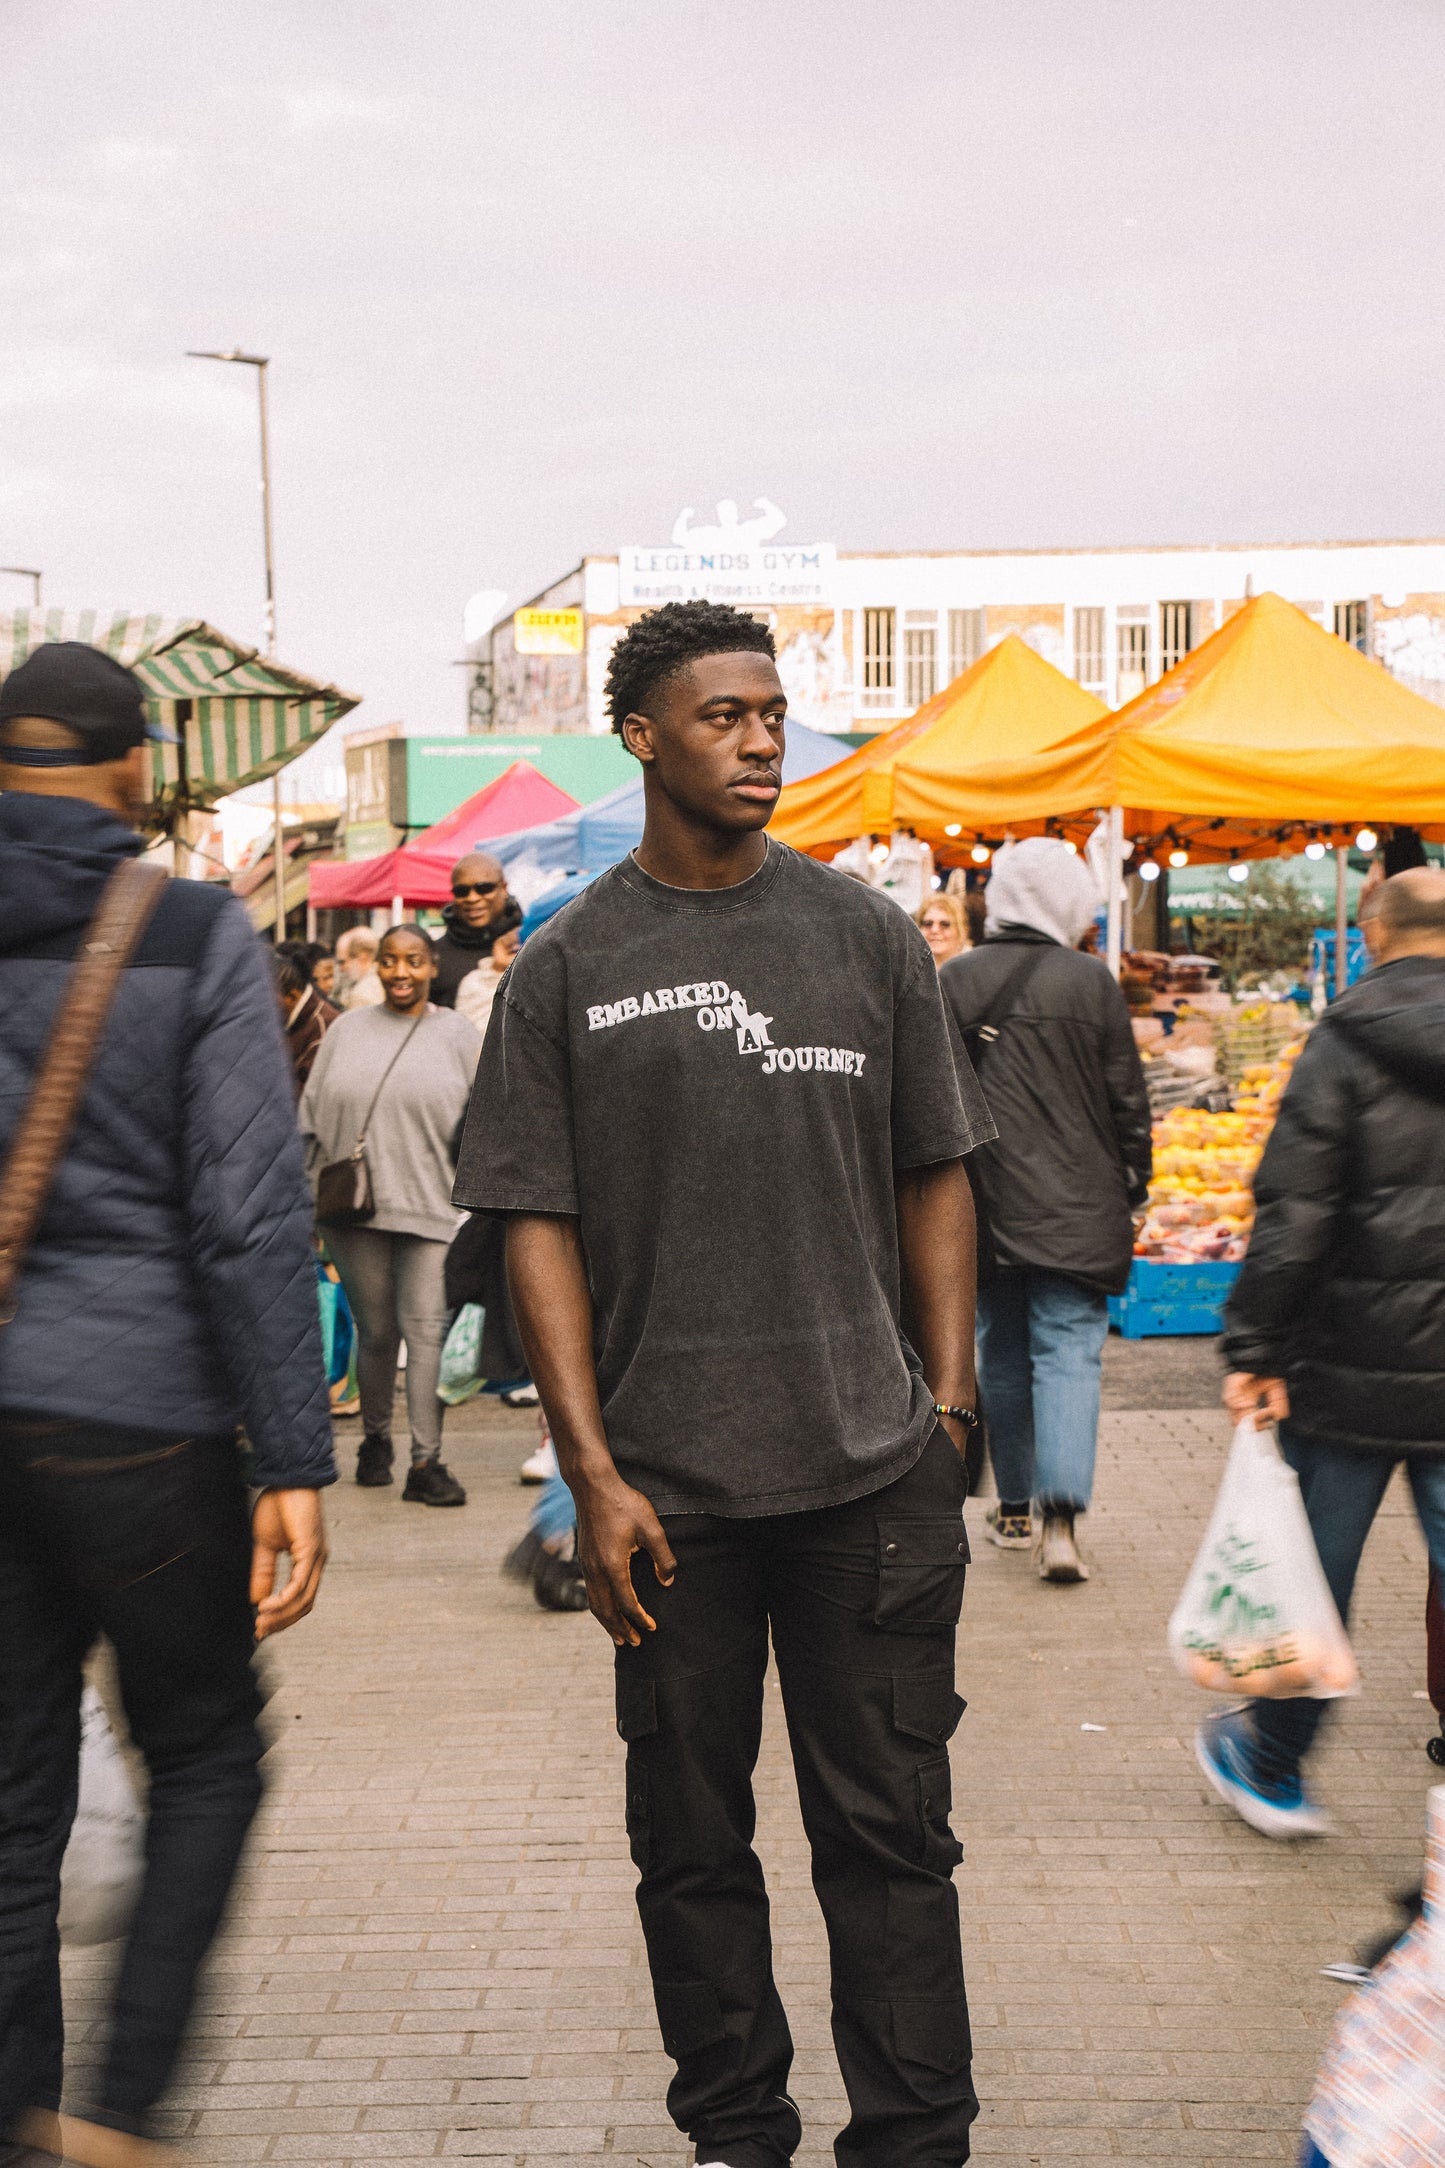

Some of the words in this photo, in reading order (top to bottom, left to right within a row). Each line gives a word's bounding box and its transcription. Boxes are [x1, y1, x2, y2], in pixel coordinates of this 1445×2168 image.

[633, 554, 750, 572] LEGENDS
[763, 552, 820, 570] GYM
[586, 981, 730, 1031] EMBARKED
[697, 1005, 733, 1031] ON
[741, 1027, 760, 1051] A
[761, 1047, 866, 1077] JOURNEY
